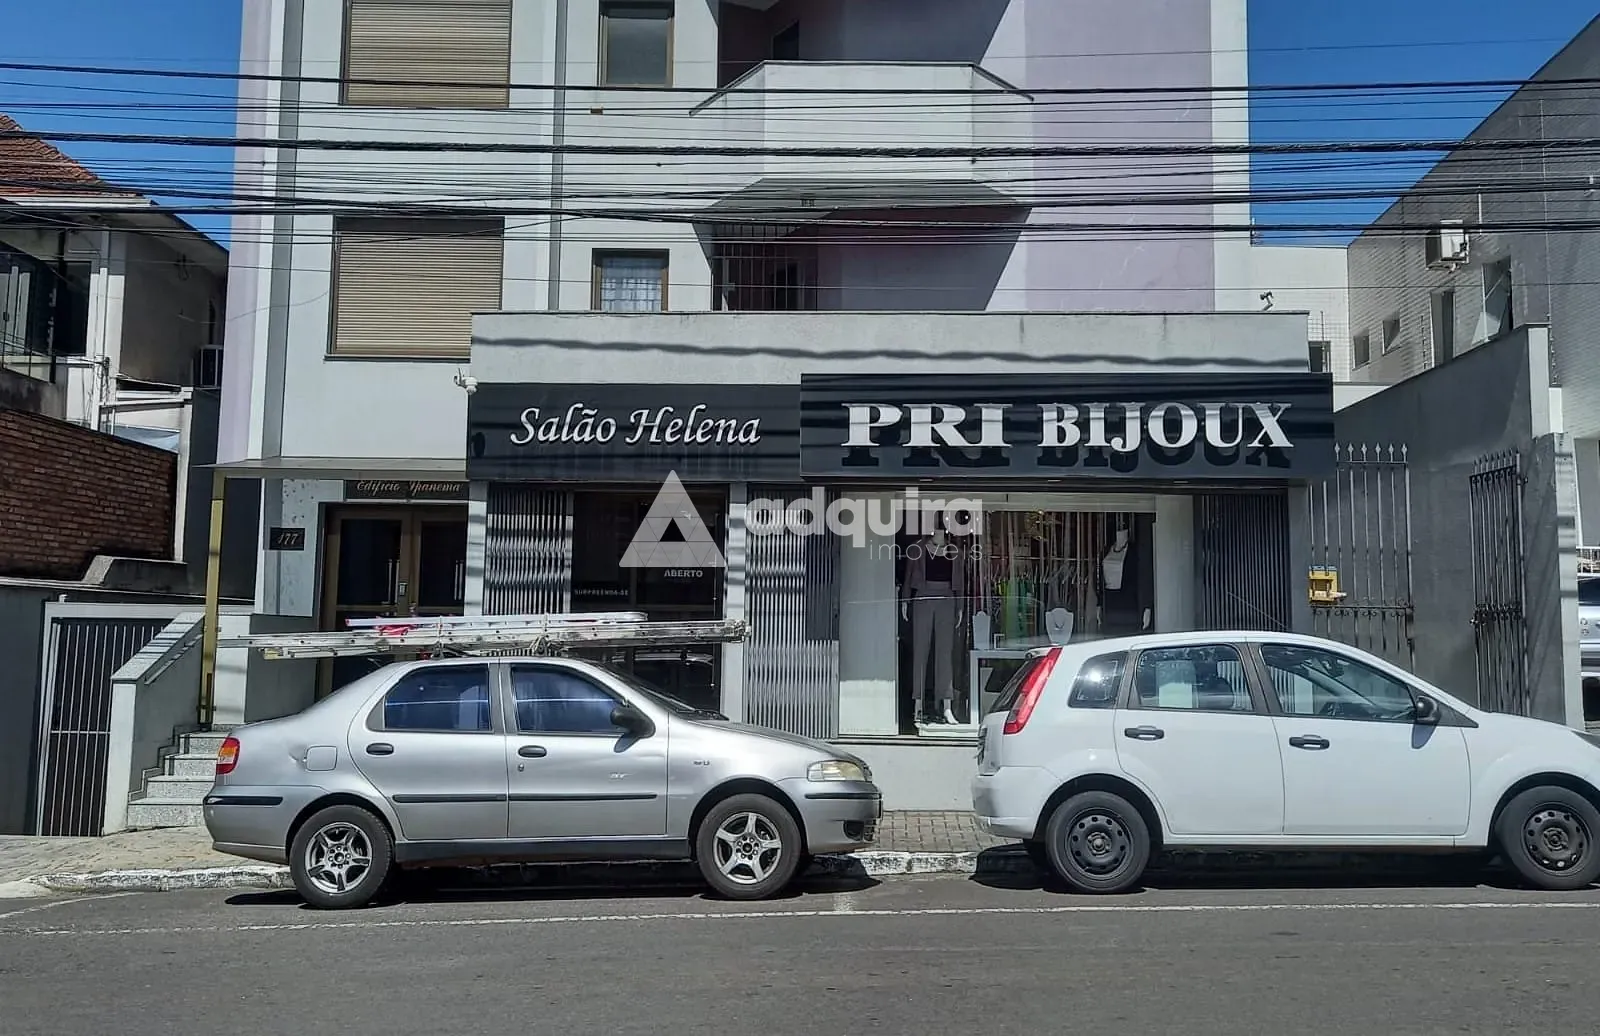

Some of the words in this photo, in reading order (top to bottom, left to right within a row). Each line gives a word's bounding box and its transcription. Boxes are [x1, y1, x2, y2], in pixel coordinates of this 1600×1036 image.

[510, 403, 618, 445] Salão
[625, 403, 762, 445] Helena
[840, 402, 1013, 448] PRI
[1036, 401, 1295, 453] BIJOUX
[664, 568, 704, 578] ABERTO
